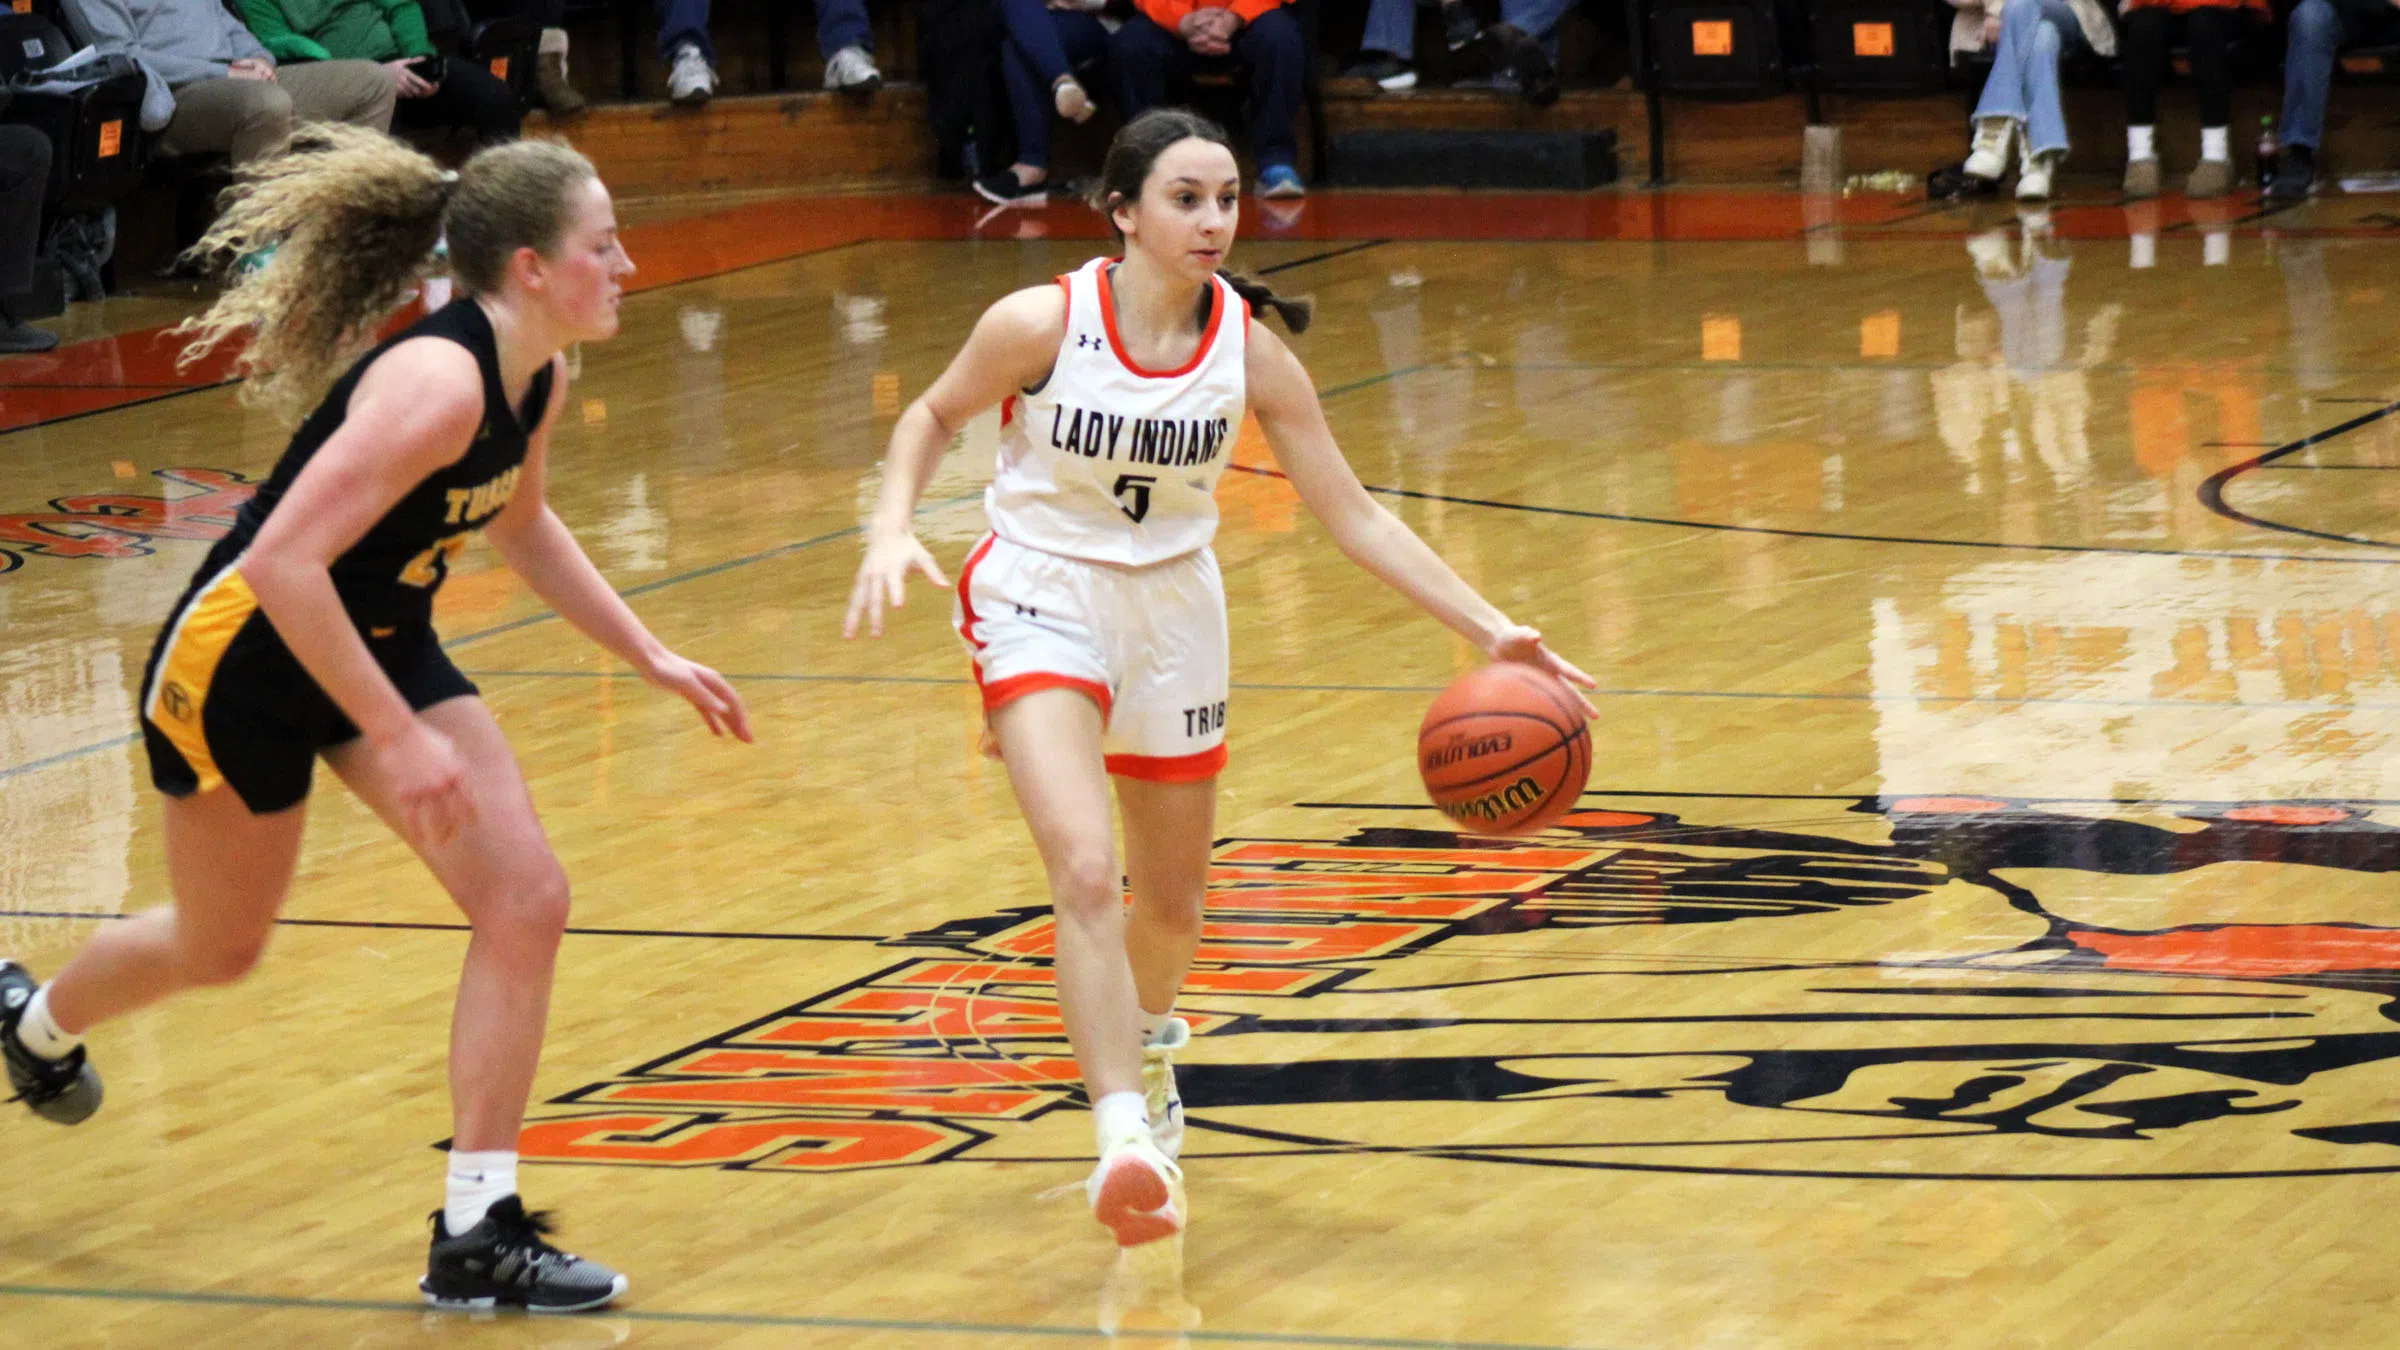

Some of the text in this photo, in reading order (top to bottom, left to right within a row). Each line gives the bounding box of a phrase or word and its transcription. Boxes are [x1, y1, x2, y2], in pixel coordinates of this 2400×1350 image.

[1051, 403, 1228, 467] LADY INDIANS
[1113, 474, 1157, 524] 5
